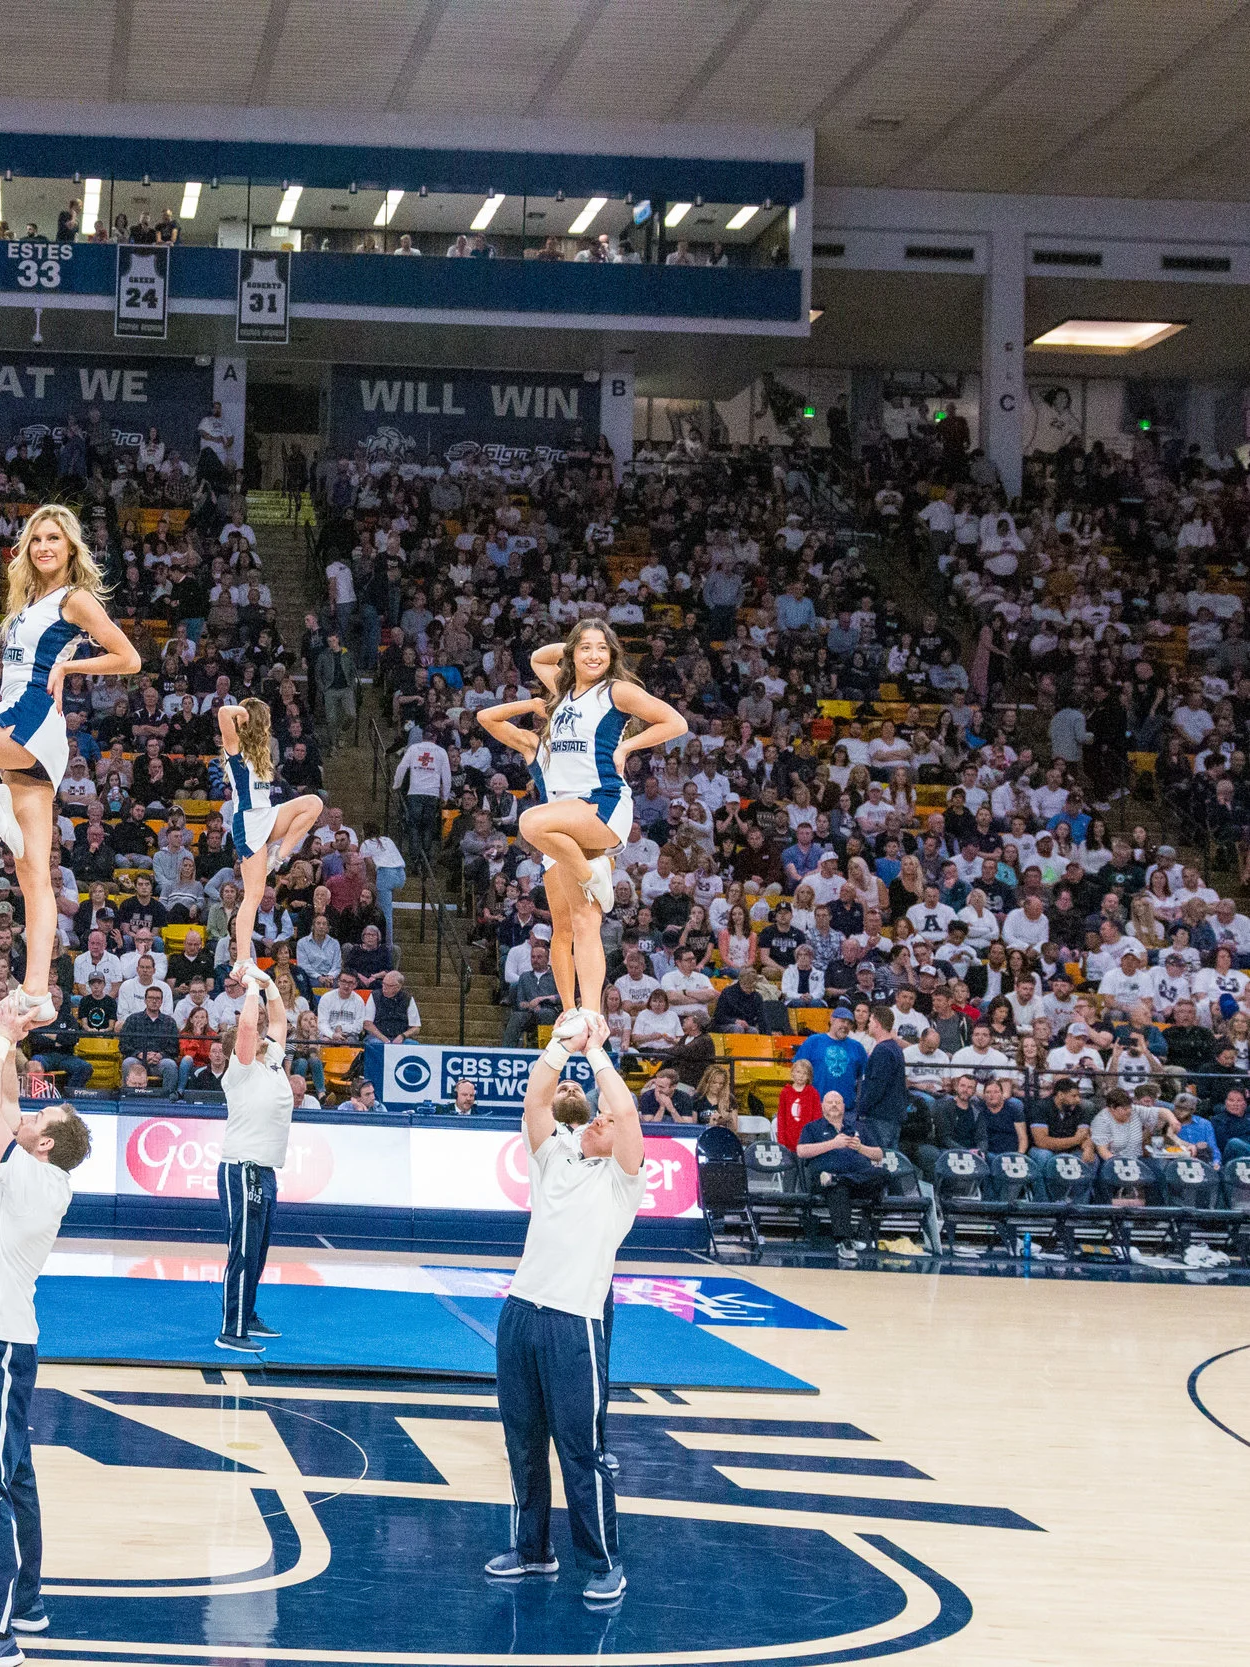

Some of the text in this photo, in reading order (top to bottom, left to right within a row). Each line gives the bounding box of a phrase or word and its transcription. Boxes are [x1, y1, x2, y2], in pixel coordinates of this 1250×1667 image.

[7, 242, 73, 260] ESTES
[17, 260, 61, 288] 33
[125, 287, 158, 309] 24
[249, 293, 278, 314] 31
[223, 364, 238, 382] A
[78, 367, 149, 402] WE
[611, 379, 626, 397] B
[358, 379, 580, 420] WILL WIN
[999, 394, 1015, 412] C
[446, 1057, 592, 1080] CBS SPTS
[137, 1120, 313, 1192] Gosr
